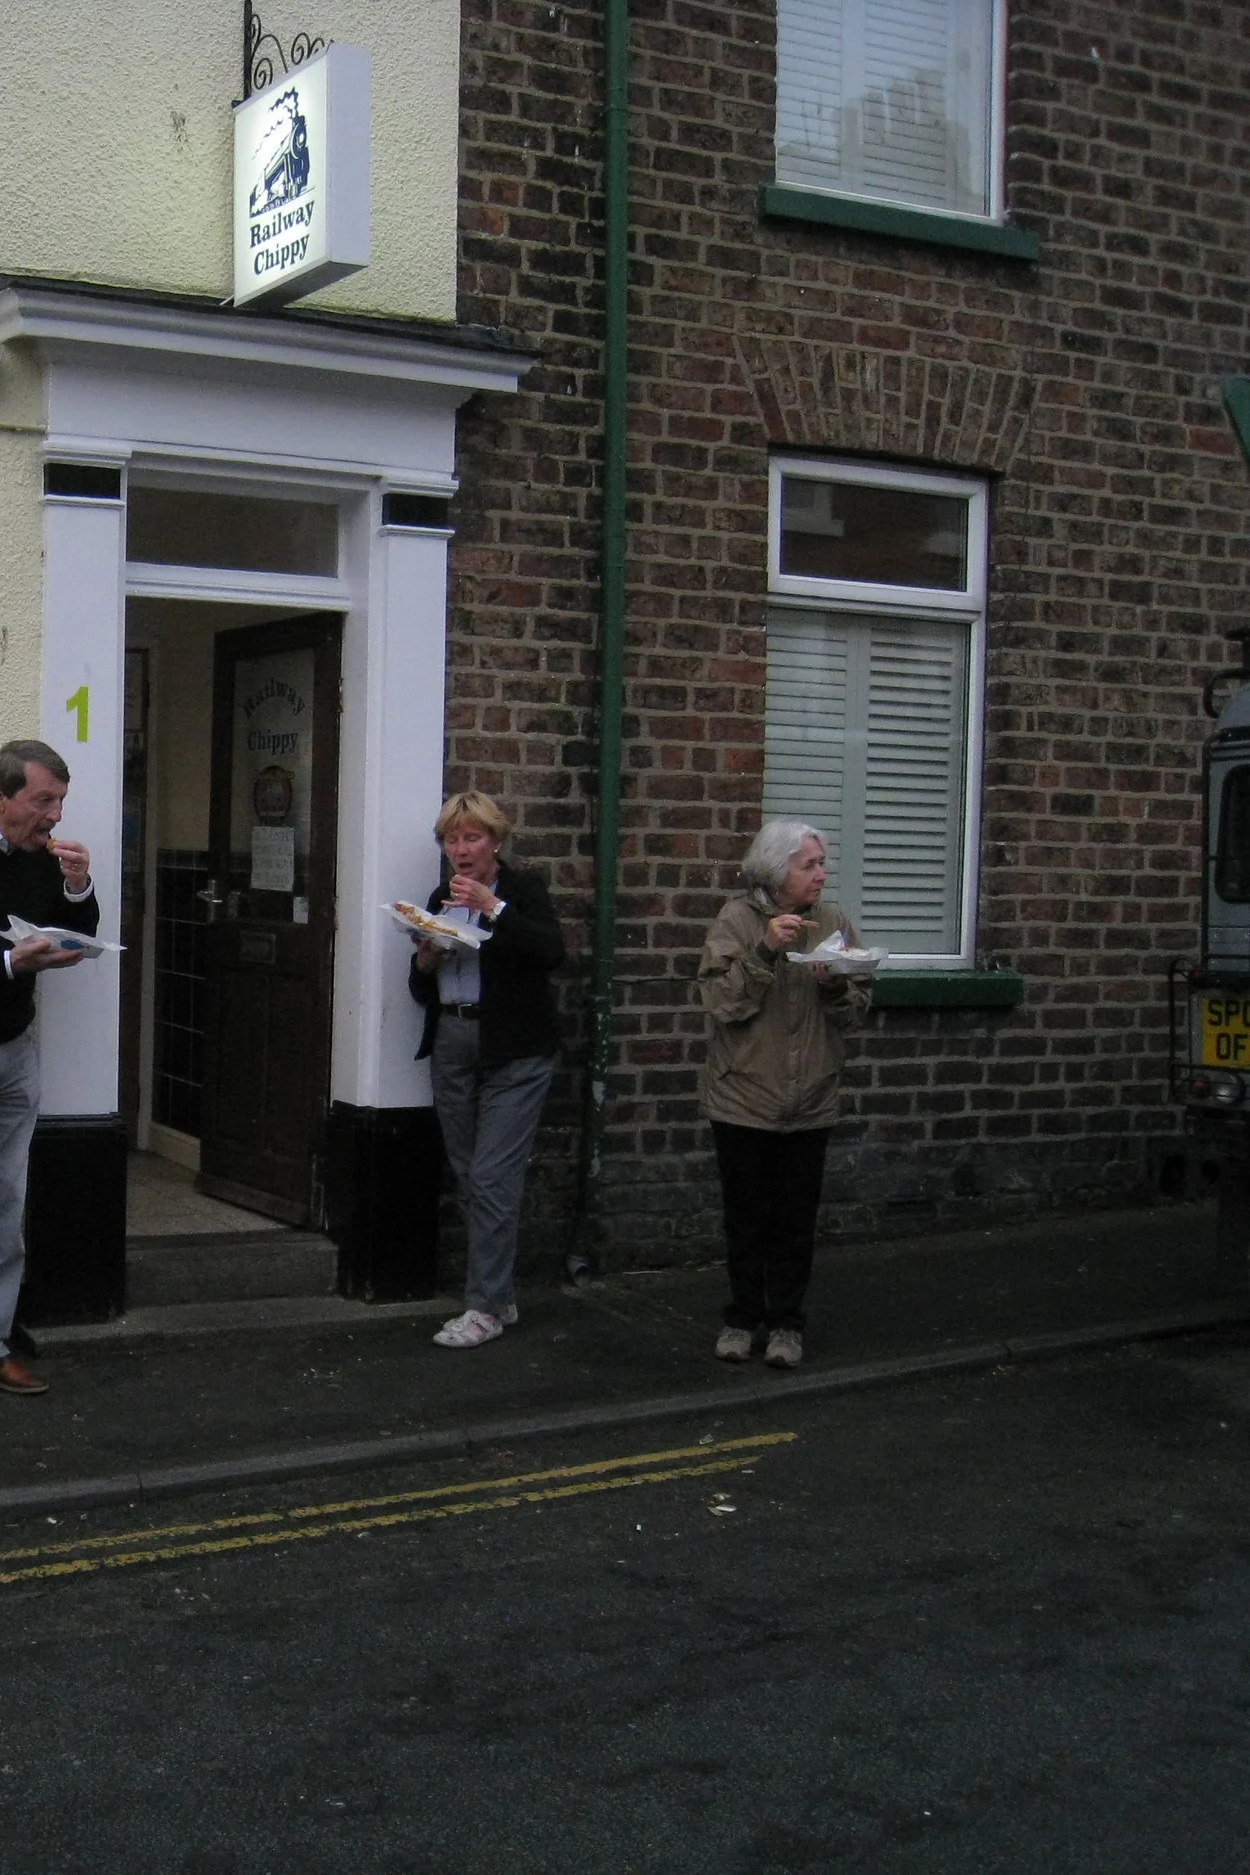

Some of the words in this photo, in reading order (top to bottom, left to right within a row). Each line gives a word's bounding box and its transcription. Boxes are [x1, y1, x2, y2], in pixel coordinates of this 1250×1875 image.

[250, 200, 315, 248] Railway
[253, 233, 310, 276] Chippy
[65, 685, 90, 744] 1
[248, 728, 299, 756] Chippy
